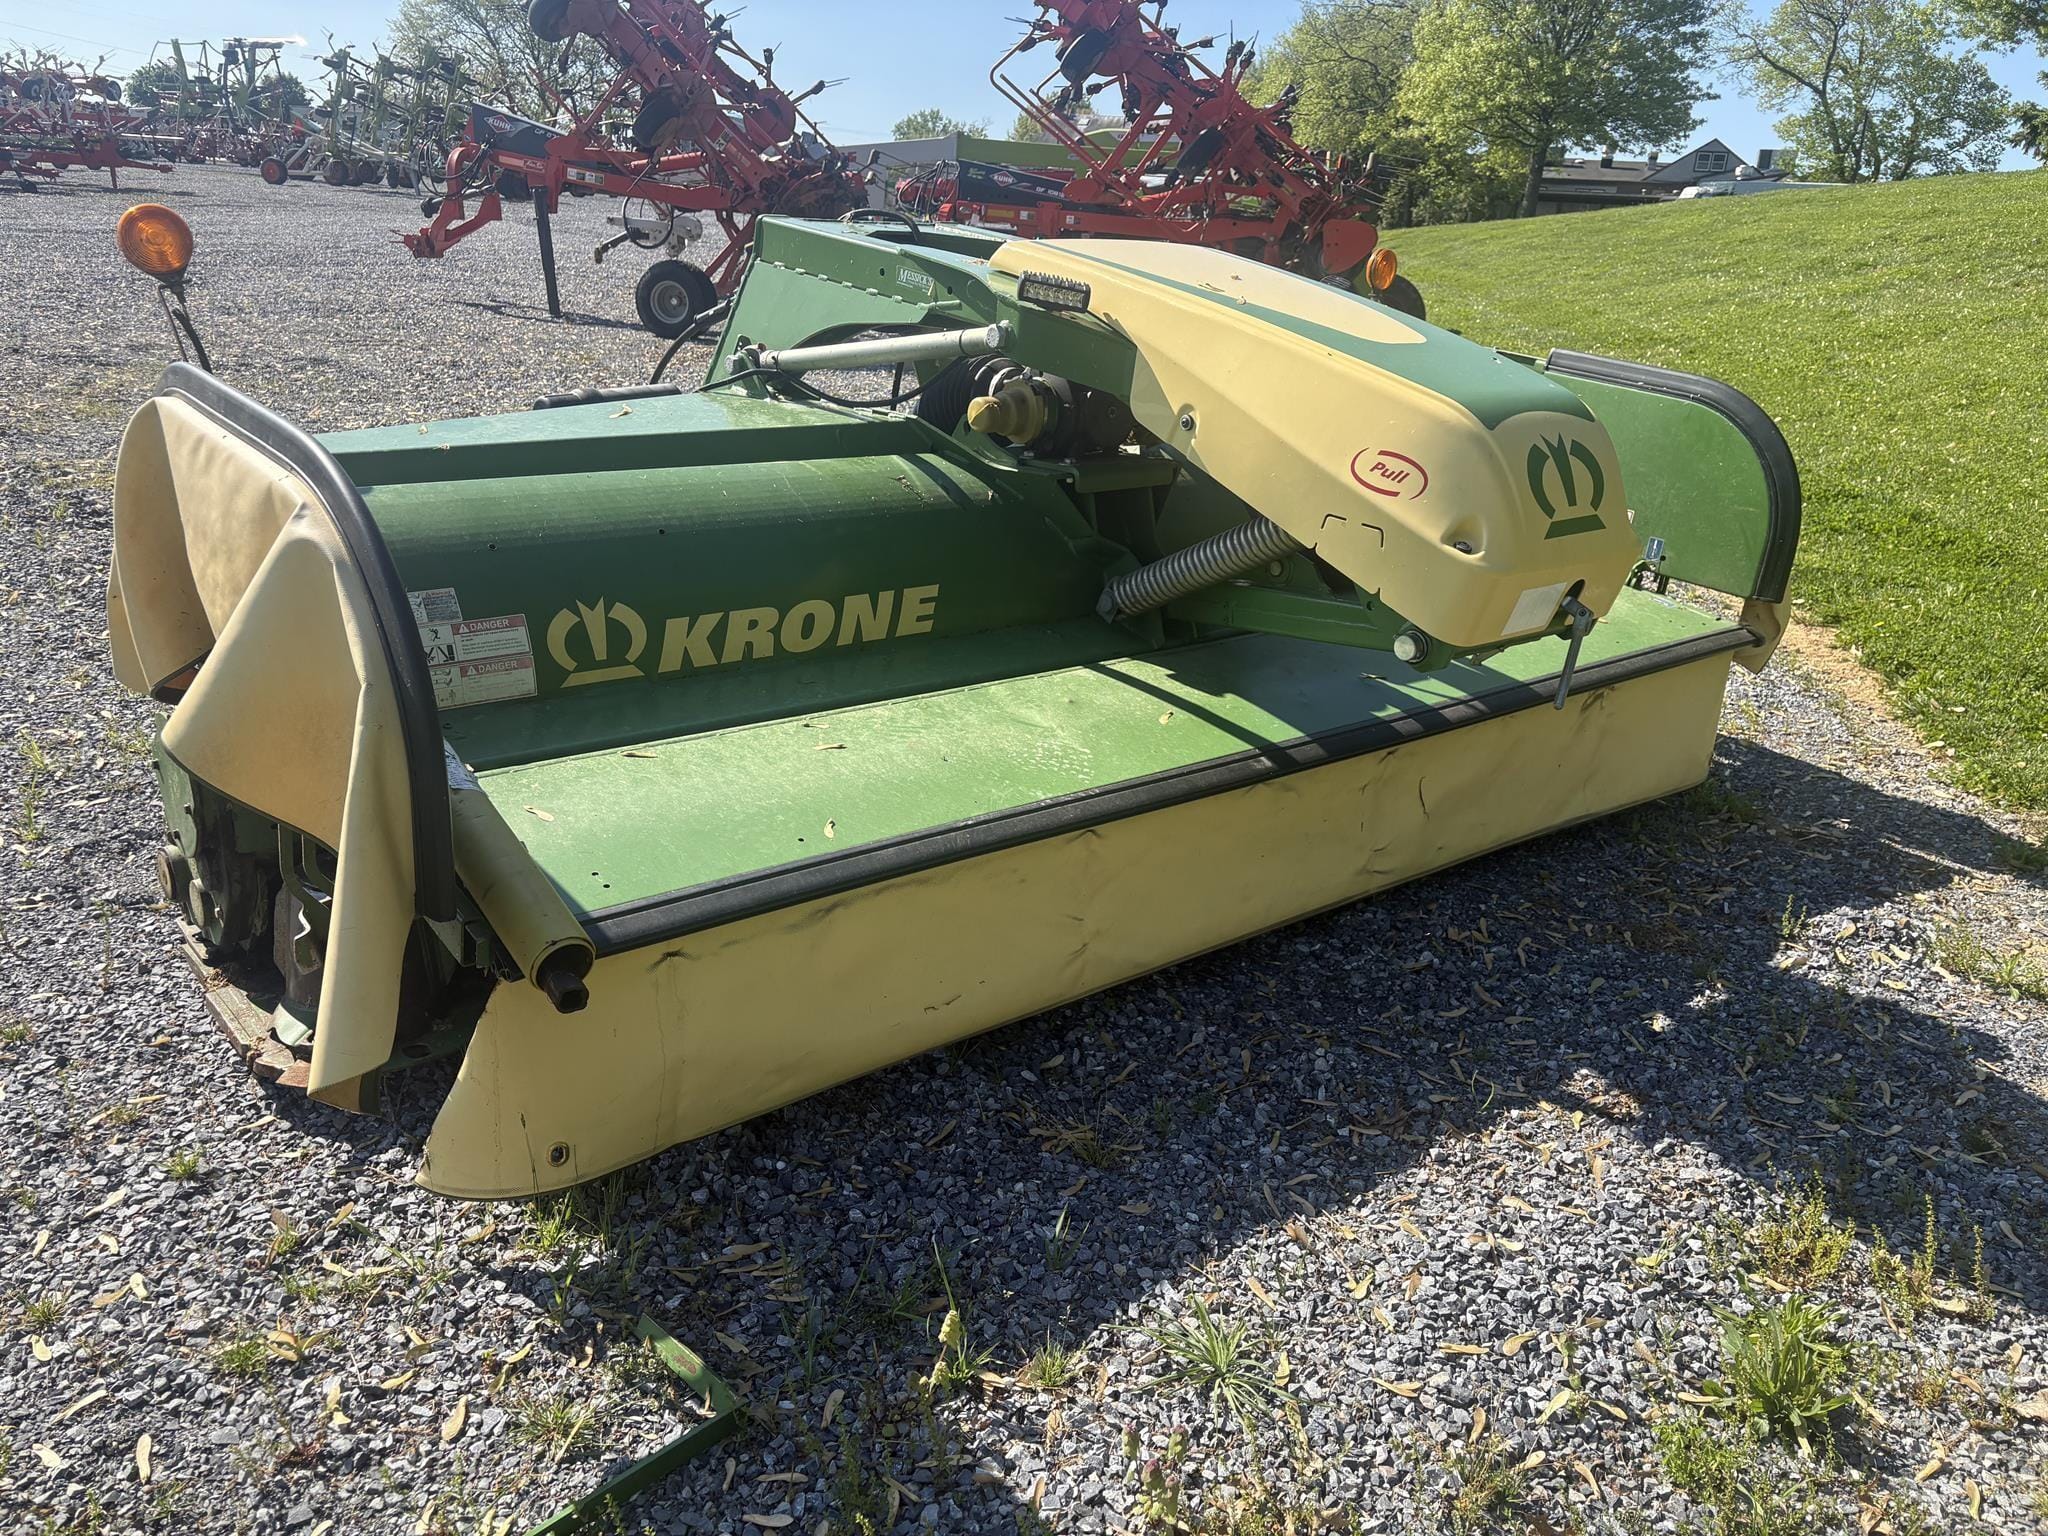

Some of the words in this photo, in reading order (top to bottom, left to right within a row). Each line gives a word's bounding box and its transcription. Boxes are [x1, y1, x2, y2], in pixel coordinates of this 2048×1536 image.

[488, 118, 512, 131] KUHN
[993, 175, 1014, 184] KUHN
[1369, 461, 1411, 484] Pull
[470, 618, 510, 631] DANGER
[657, 583, 940, 674] KRONE
[478, 660, 518, 673] DANGER
